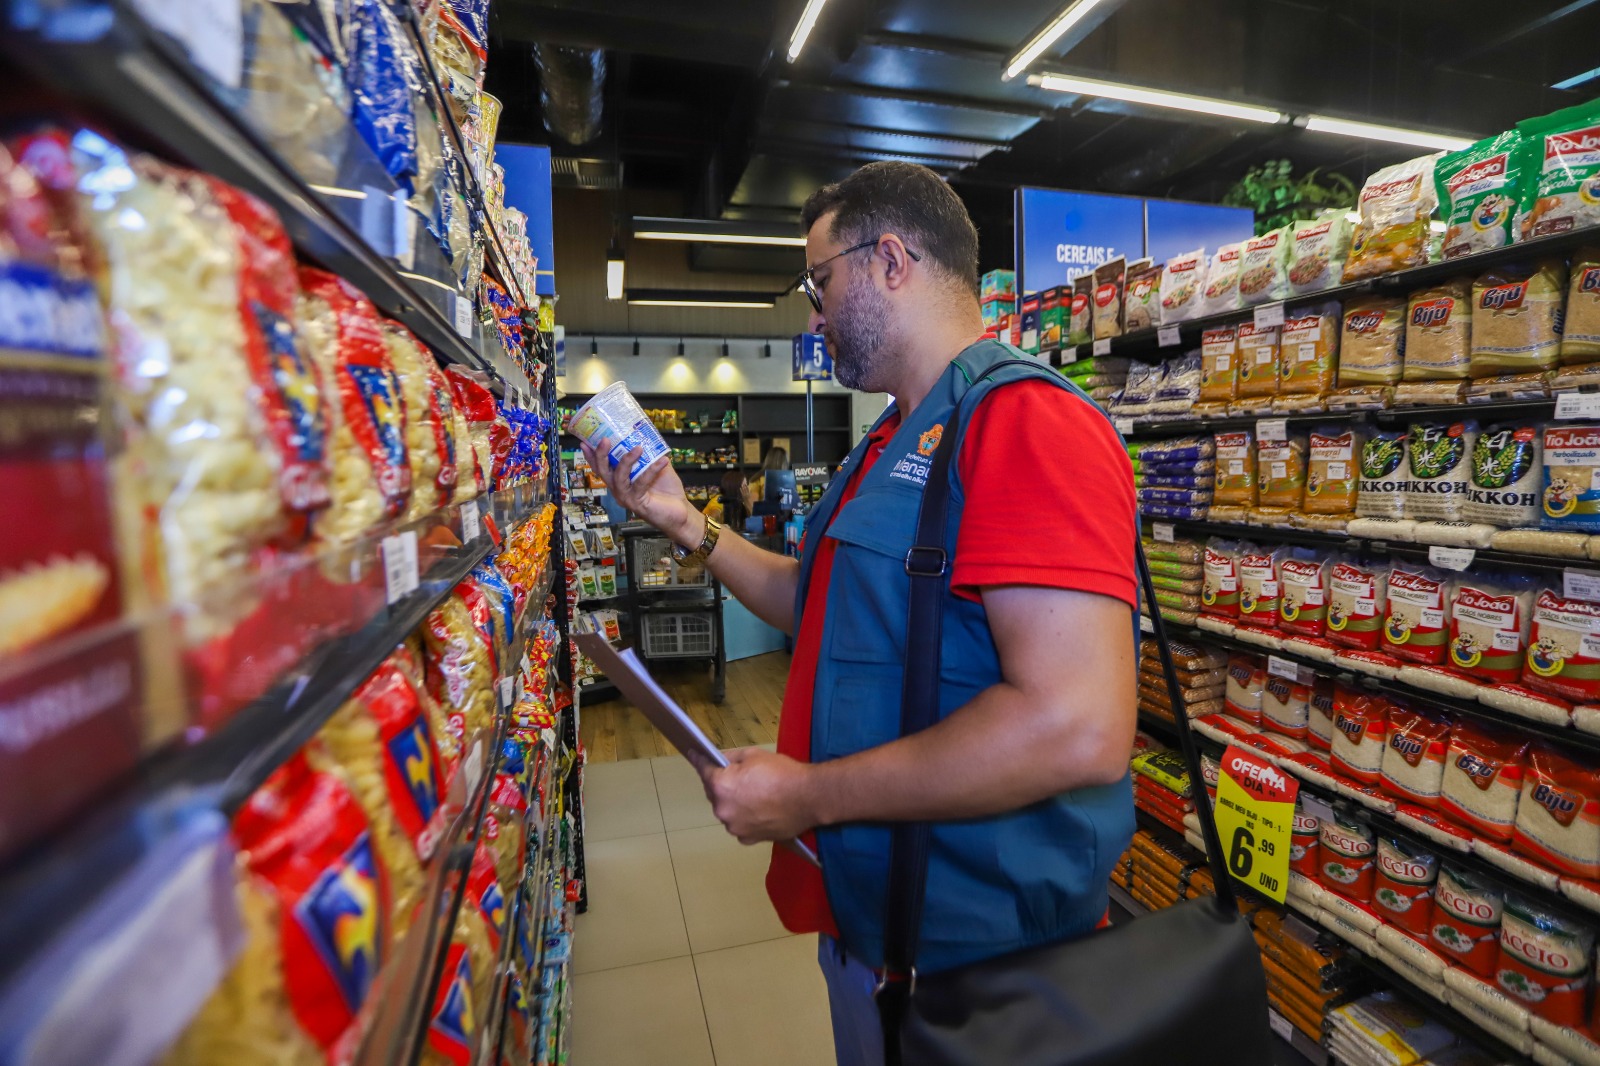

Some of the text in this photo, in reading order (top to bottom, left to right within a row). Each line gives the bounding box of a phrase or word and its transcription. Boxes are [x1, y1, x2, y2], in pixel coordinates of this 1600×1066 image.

[1574, 133, 1600, 149] Jo
[1056, 244, 1105, 265] CEREAIS
[1482, 285, 1523, 308] Biju
[1412, 305, 1448, 326] Biju
[813, 342, 823, 367] 5
[1545, 435, 1563, 446] Tio
[1312, 448, 1341, 458] Integral
[795, 466, 827, 477] RAYOVAC
[1359, 481, 1408, 493] IKKOH
[1283, 562, 1297, 572] Tio
[1391, 574, 1406, 586] Tio
[1406, 590, 1429, 601] NOBRES
[1460, 593, 1511, 611] Tio João
[1539, 595, 1558, 608] Tio
[1458, 607, 1503, 622] GRÃOS NOBRES
[1539, 610, 1593, 625] GRÃOS NOBRES
[1268, 679, 1290, 696] Biju
[1336, 714, 1362, 734] Biju
[1391, 732, 1423, 754] Biju
[1457, 754, 1496, 778] Biju
[1243, 778, 1264, 794] DIA
[1533, 783, 1576, 813] Biju
[1235, 803, 1246, 815] MEU
[1246, 809, 1258, 821] BIJU
[1262, 816, 1274, 829] TIPO
[1229, 826, 1255, 878] 6
[1378, 852, 1428, 880] ACCIO
[1259, 872, 1279, 893] UND
[1500, 928, 1570, 969] ACCIO
